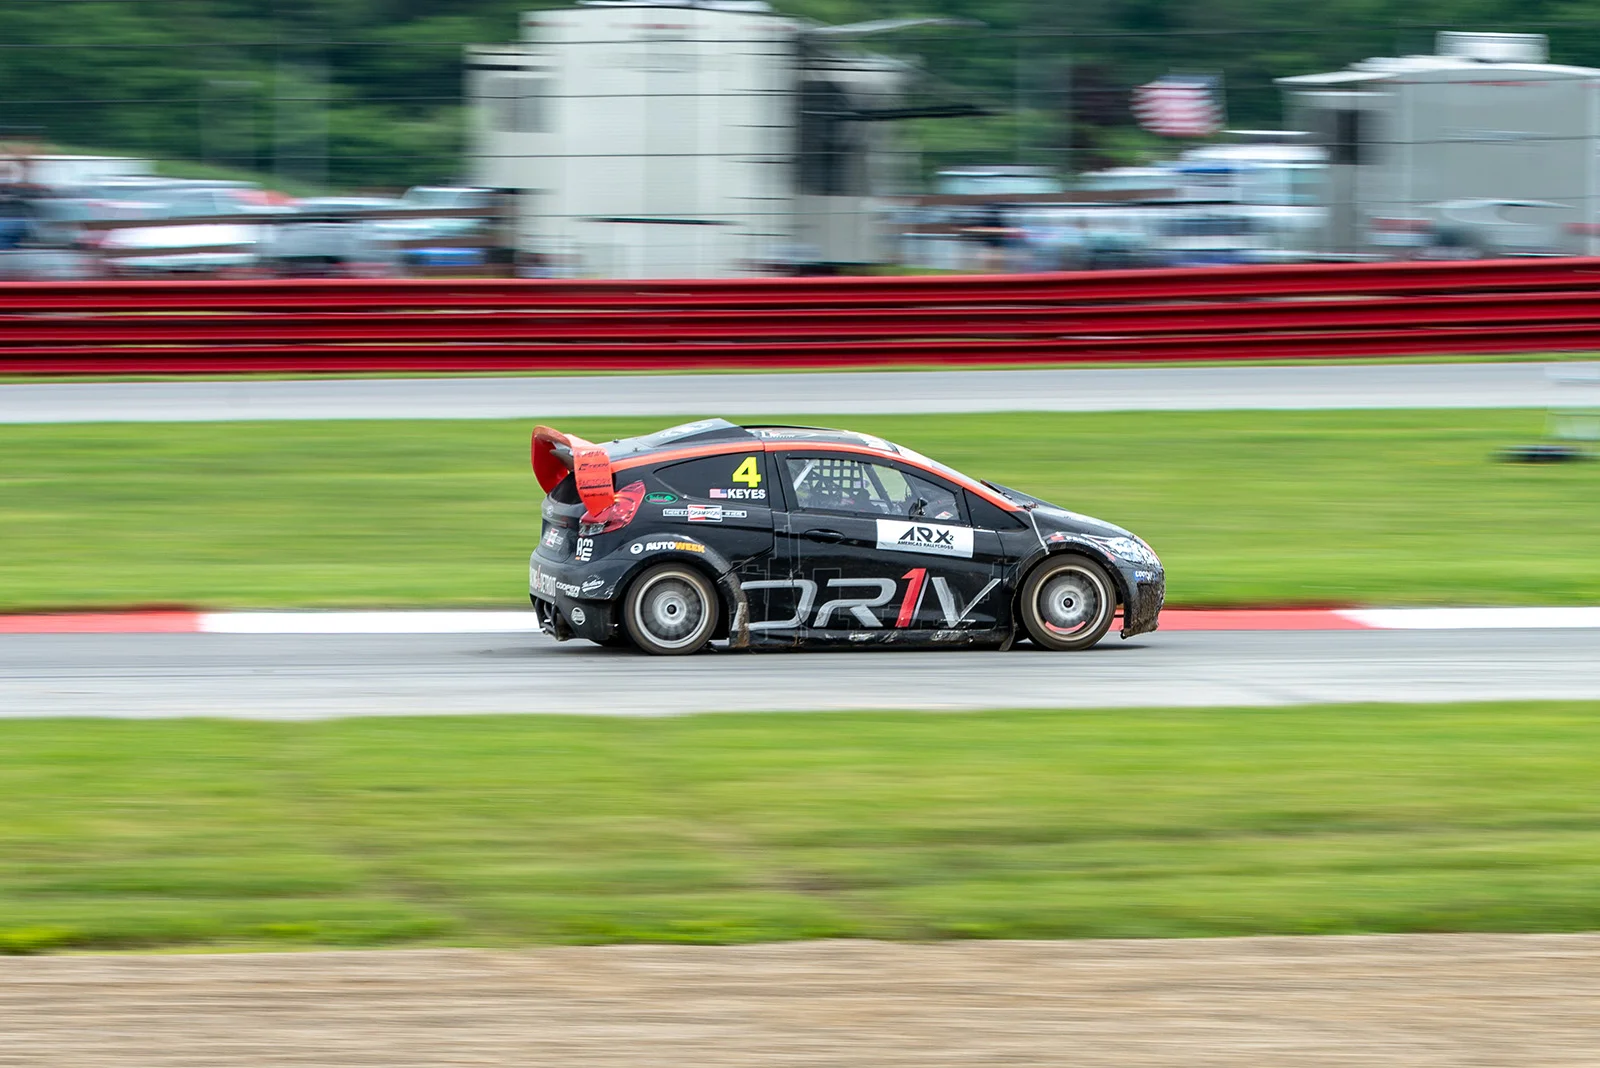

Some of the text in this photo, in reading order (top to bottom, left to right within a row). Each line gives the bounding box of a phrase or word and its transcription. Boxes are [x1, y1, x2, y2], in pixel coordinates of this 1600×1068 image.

[732, 456, 761, 488] 4
[727, 488, 766, 499] KEYES
[645, 541, 706, 554] AUTOWEEK
[556, 581, 581, 594] COOPER
